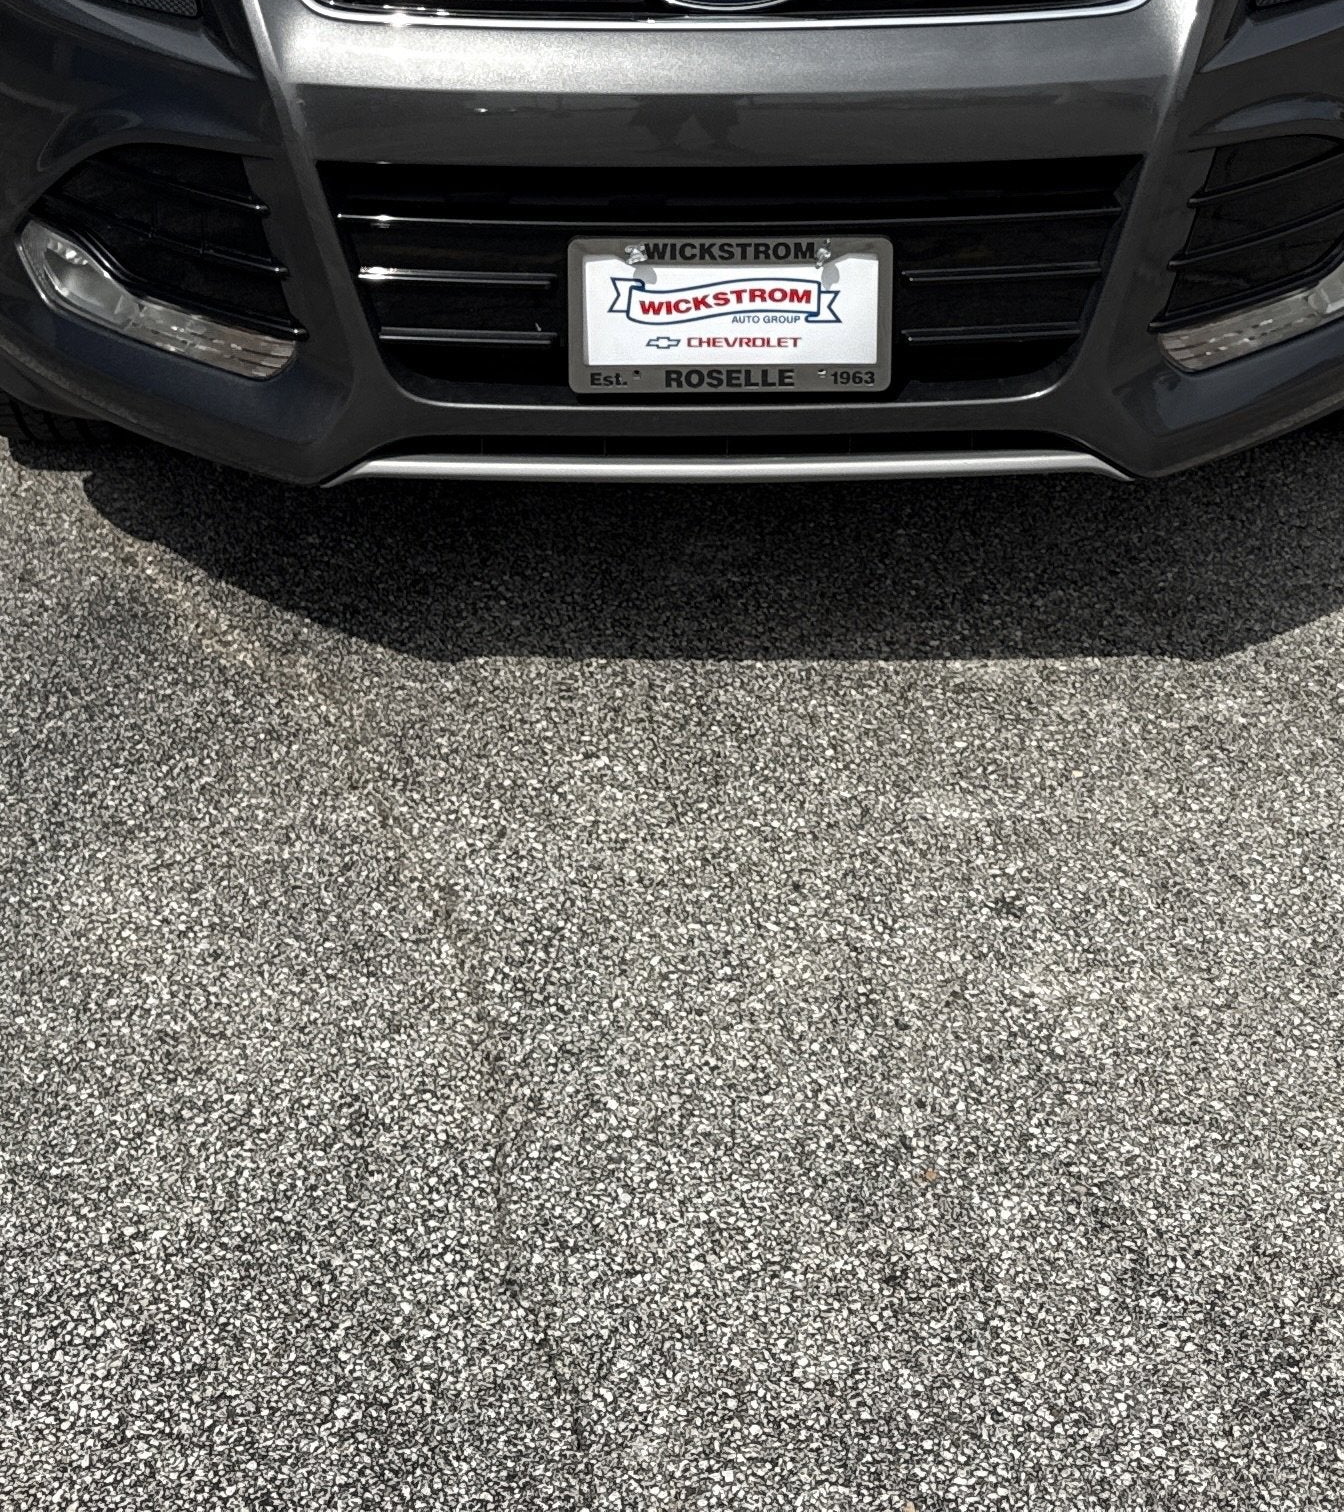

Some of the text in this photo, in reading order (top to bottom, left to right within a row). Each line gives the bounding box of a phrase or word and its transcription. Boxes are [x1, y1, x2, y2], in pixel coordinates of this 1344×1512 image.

[644, 242, 816, 261] WICKSTROM
[639, 287, 812, 316] WICKSTROM
[731, 315, 801, 324] AUTO GROUP
[686, 336, 802, 348] CHEVROLET
[589, 369, 875, 389] Est. ROSELLE 1963
